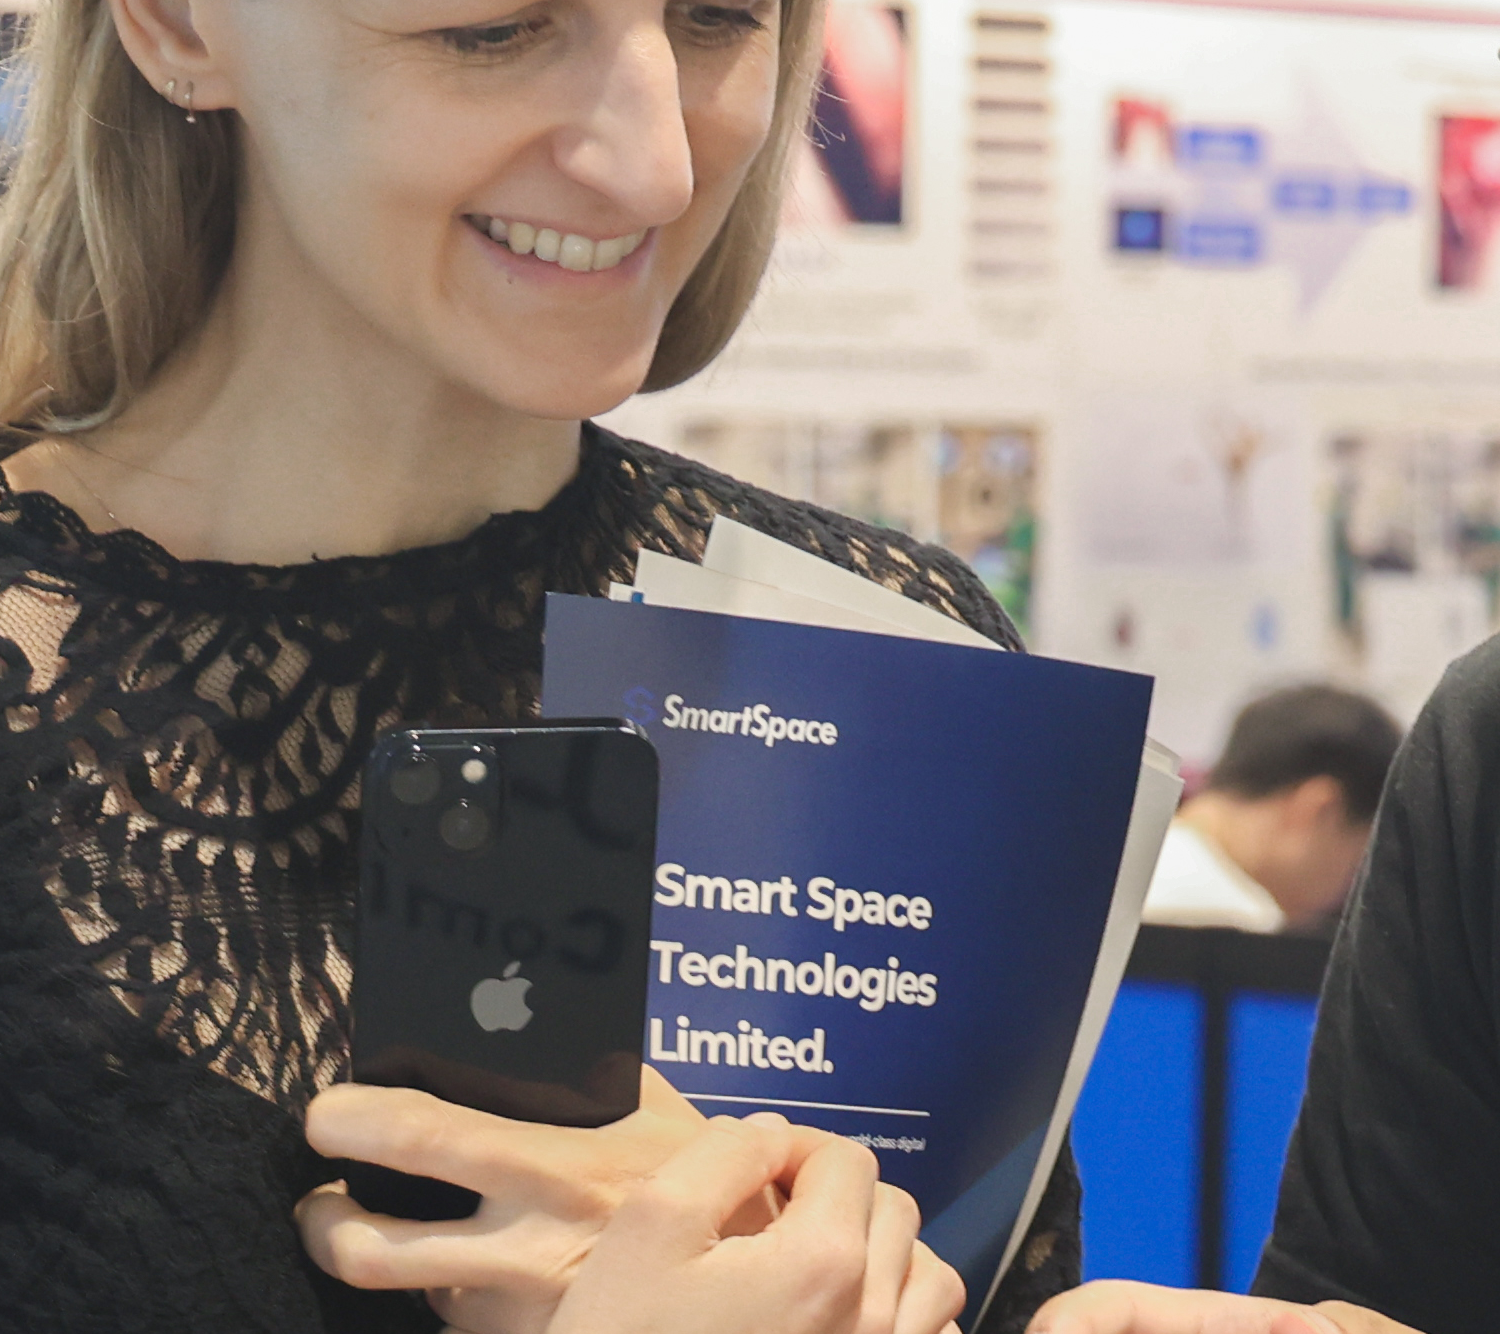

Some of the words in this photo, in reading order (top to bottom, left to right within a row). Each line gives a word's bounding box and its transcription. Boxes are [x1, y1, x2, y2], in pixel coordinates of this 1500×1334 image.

[661, 693, 839, 748] SmartSpace
[653, 862, 799, 917] Smart
[805, 876, 934, 932] Space
[649, 939, 939, 1013] Technologies
[650, 1015, 835, 1075] Limited.
